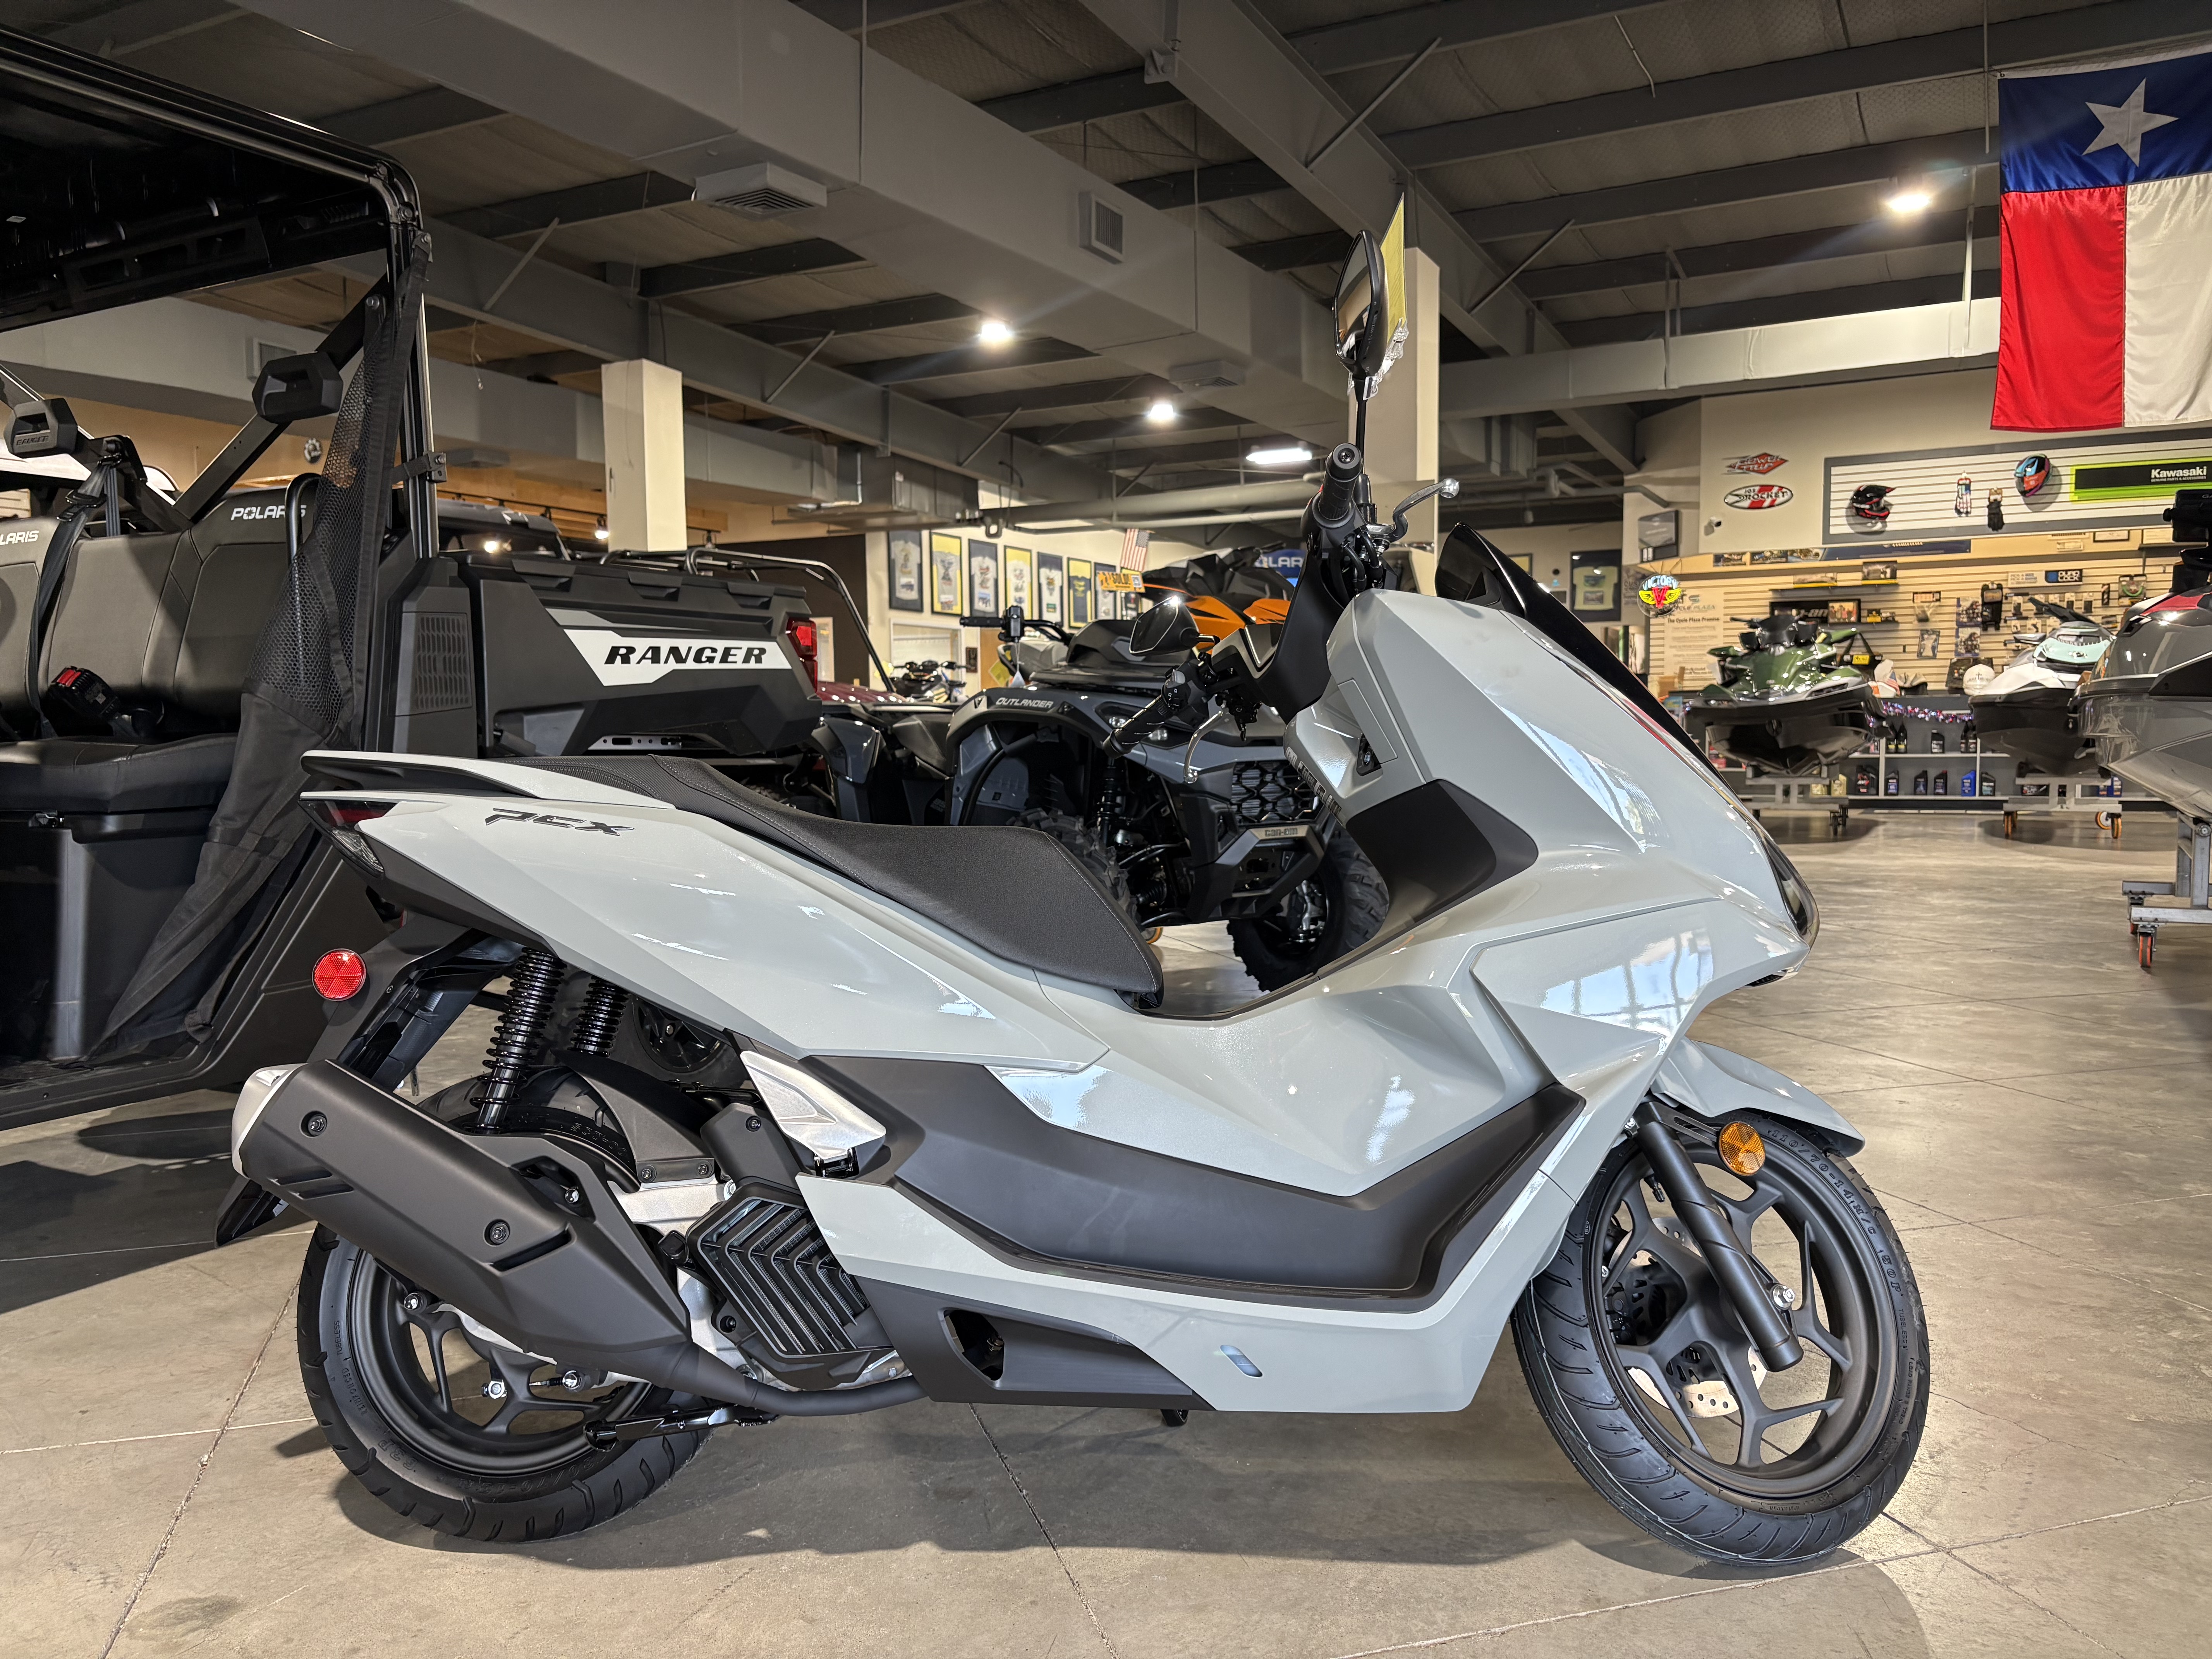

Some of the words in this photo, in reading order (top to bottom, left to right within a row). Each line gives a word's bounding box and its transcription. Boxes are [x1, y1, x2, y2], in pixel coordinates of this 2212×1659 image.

[2151, 466, 2207, 478] Kawasaki
[231, 505, 307, 521] POLARS
[0, 530, 40, 546] LARIS
[1642, 575, 1679, 591] VICTORY
[604, 646, 767, 665] RANGER
[996, 697, 1054, 708] OUTLANDER
[485, 808, 635, 836] PCX
[1881, 1255, 1901, 1292] 50P
[1898, 1309, 1908, 1344] TUBELESS
[334, 1320, 343, 1356] TUBELESS
